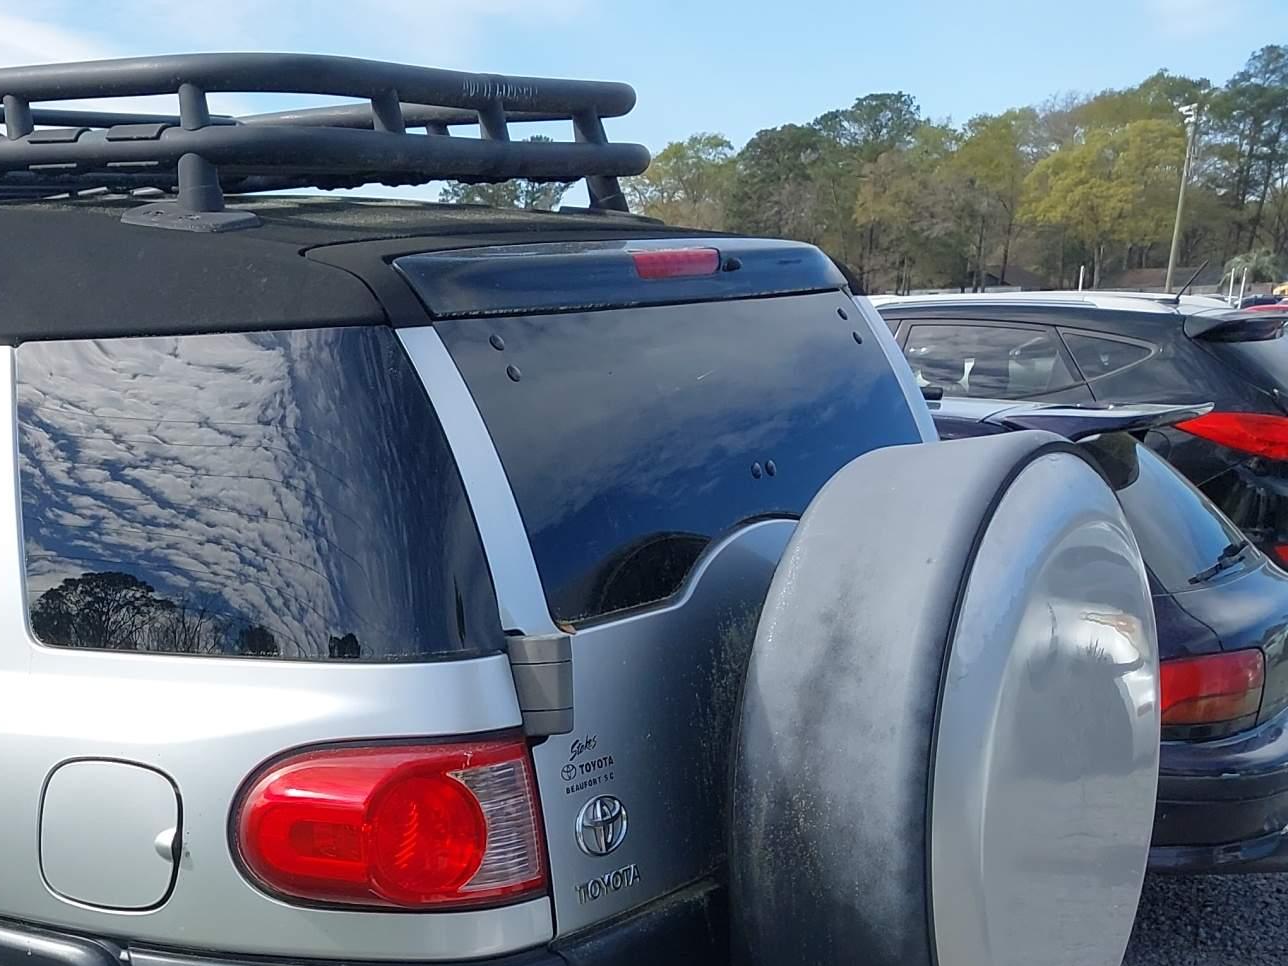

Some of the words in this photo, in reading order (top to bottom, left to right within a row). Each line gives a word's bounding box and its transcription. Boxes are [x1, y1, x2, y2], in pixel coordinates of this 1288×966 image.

[569, 734, 599, 762] Stokes
[578, 755, 614, 776] TOYOTA
[566, 775, 602, 795] BEAUFORT
[574, 863, 642, 905] TOYOTA
